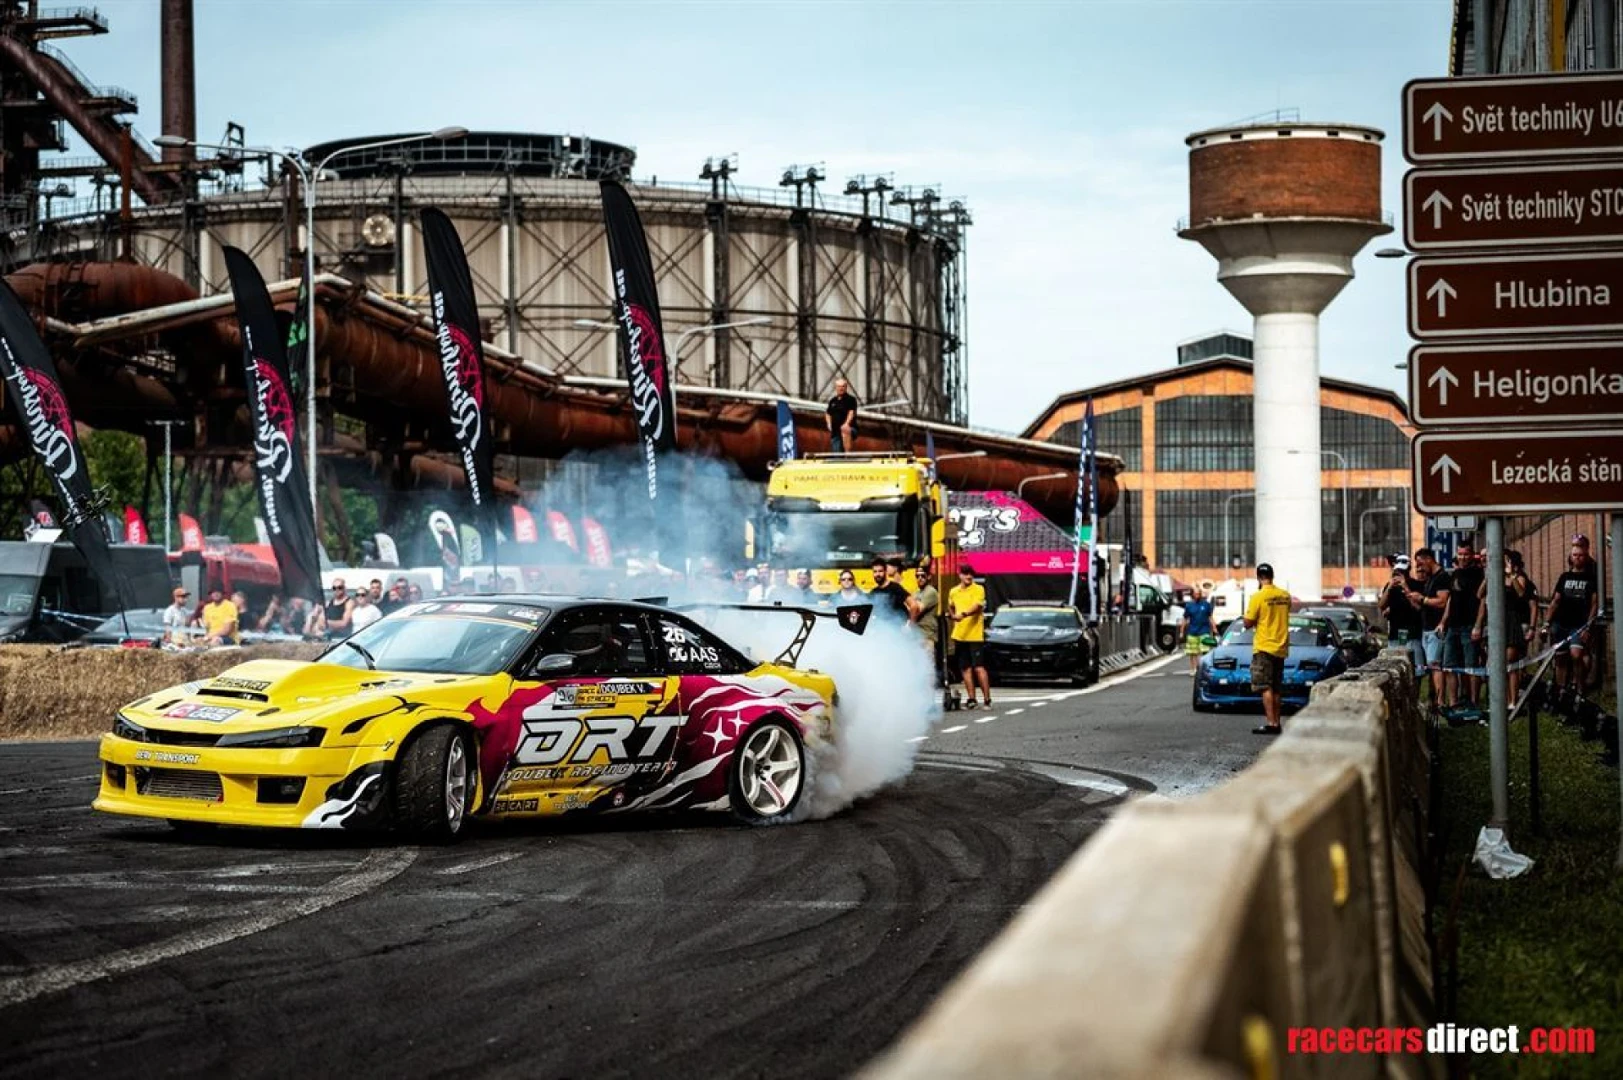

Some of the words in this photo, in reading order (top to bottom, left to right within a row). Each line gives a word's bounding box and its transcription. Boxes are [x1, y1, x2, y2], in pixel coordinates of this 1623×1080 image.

[1462, 104, 1504, 133] Svět
[1511, 102, 1594, 136] techniky
[1462, 193, 1501, 222] Svět
[1508, 190, 1585, 224] techniky
[1495, 279, 1611, 309] Hlubina
[1473, 367, 1623, 403] Heligonka
[1492, 457, 1572, 485] Lezecká
[661, 627, 686, 643] 26
[600, 683, 636, 694] DOUBEK
[516, 716, 689, 764] DRT
[156, 751, 199, 763] TRANSPORT
